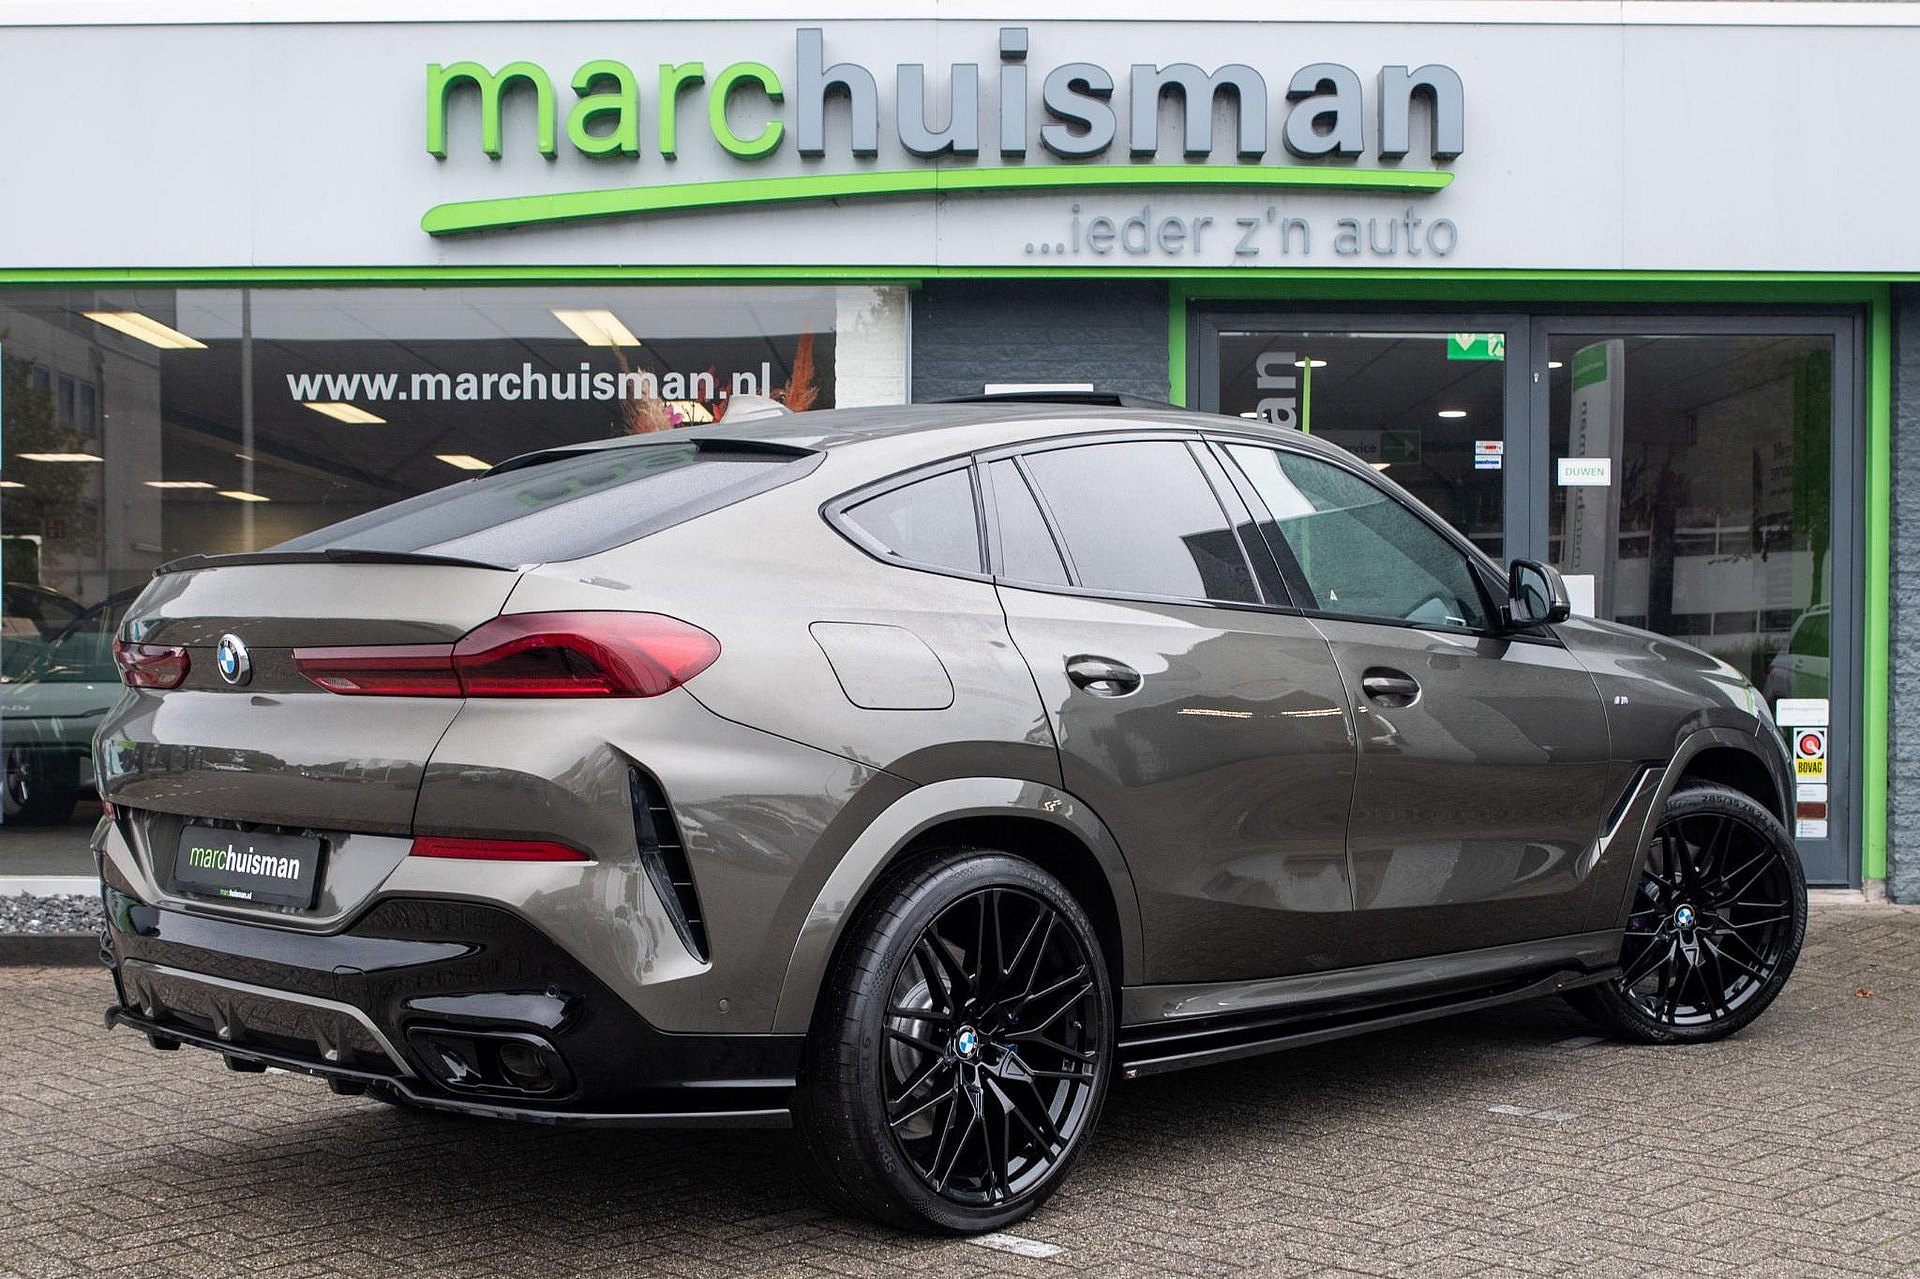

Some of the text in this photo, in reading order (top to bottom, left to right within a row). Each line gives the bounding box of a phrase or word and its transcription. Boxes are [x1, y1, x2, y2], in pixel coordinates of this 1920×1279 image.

[426, 27, 1465, 162] marchuisman
[1234, 206, 1311, 256] z'n
[1333, 206, 1458, 257] auto
[286, 361, 771, 401] www.marchuisman.nl
[1565, 467, 1604, 477] DUWEN
[1797, 761, 1823, 774] BOVAG
[189, 844, 300, 880] marchuisman
